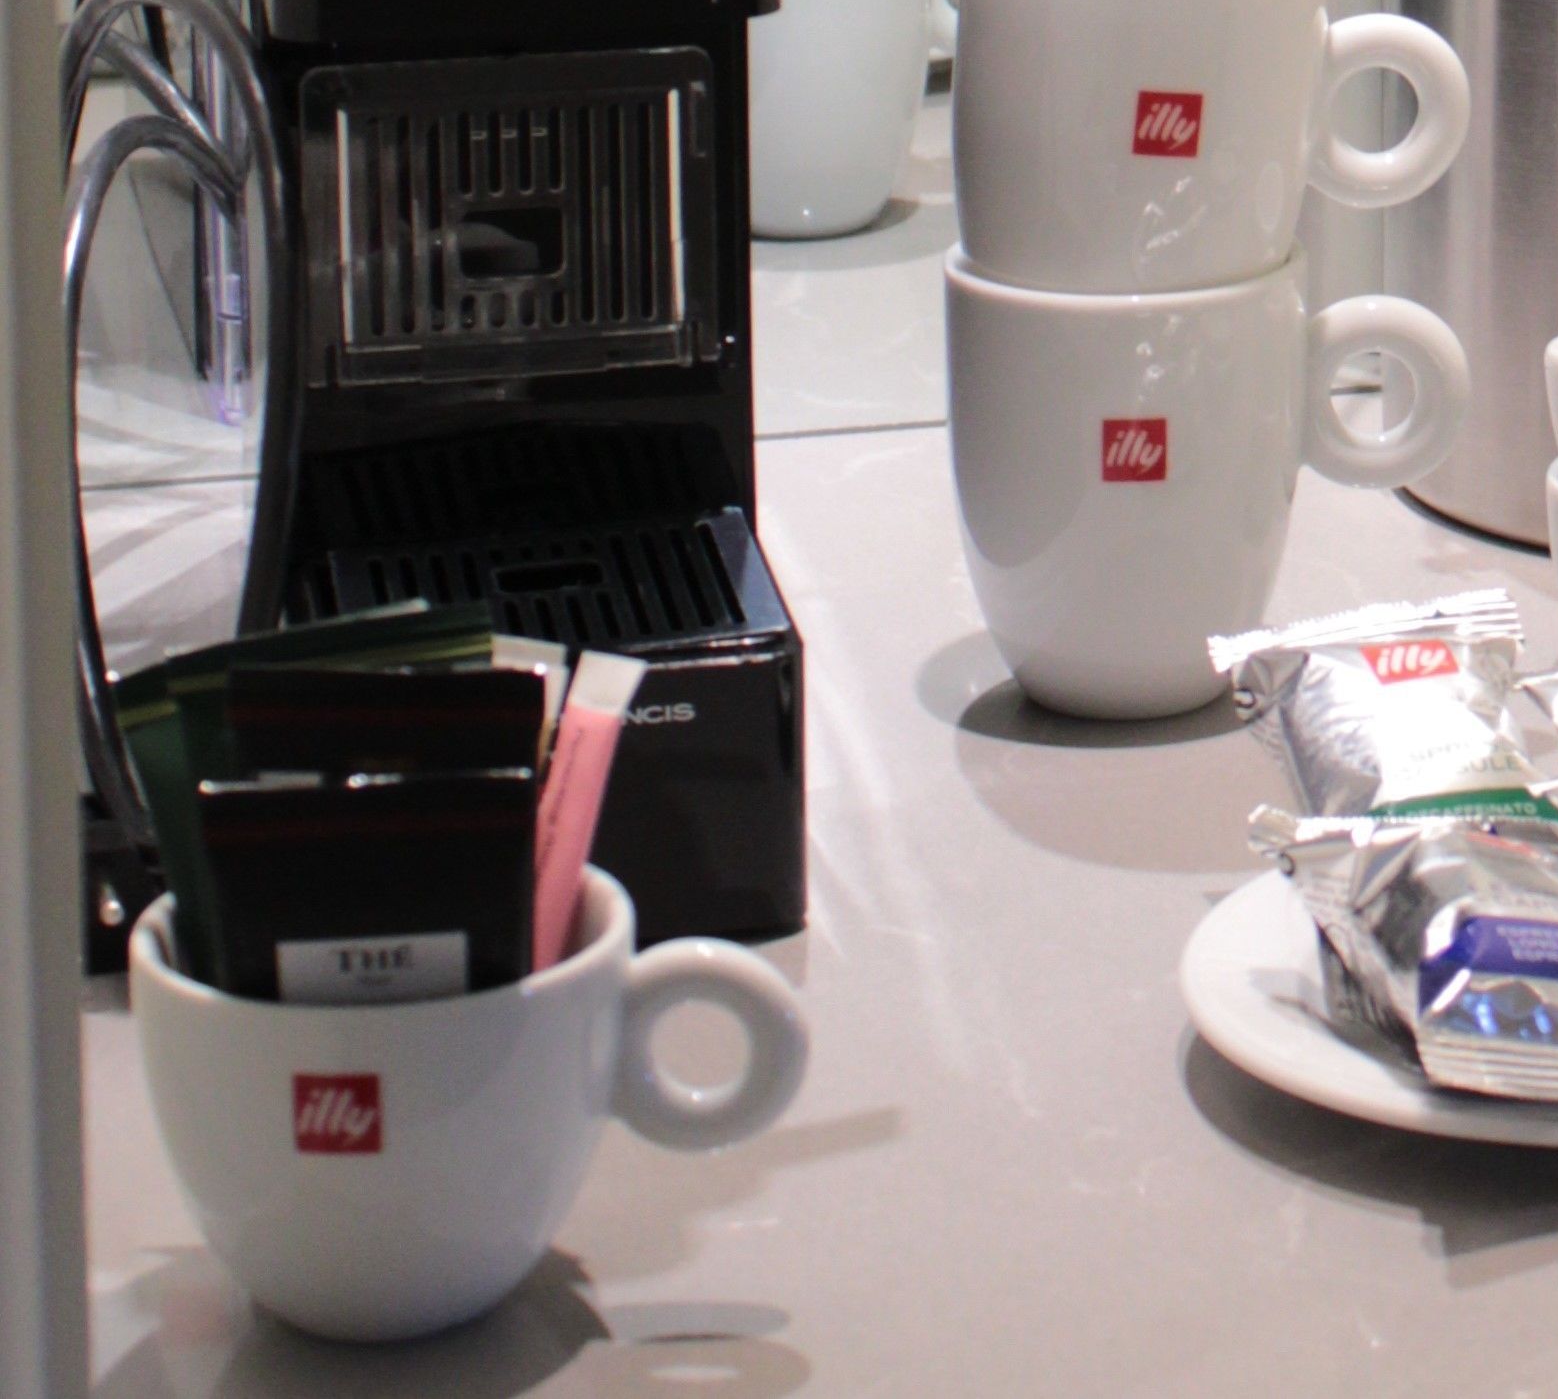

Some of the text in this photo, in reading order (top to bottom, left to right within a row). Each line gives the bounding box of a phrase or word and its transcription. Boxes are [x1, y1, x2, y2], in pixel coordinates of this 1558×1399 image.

[1137, 102, 1197, 151] illy
[1106, 427, 1163, 475] illy
[1376, 645, 1448, 676] illy
[297, 1088, 375, 1144] illy
